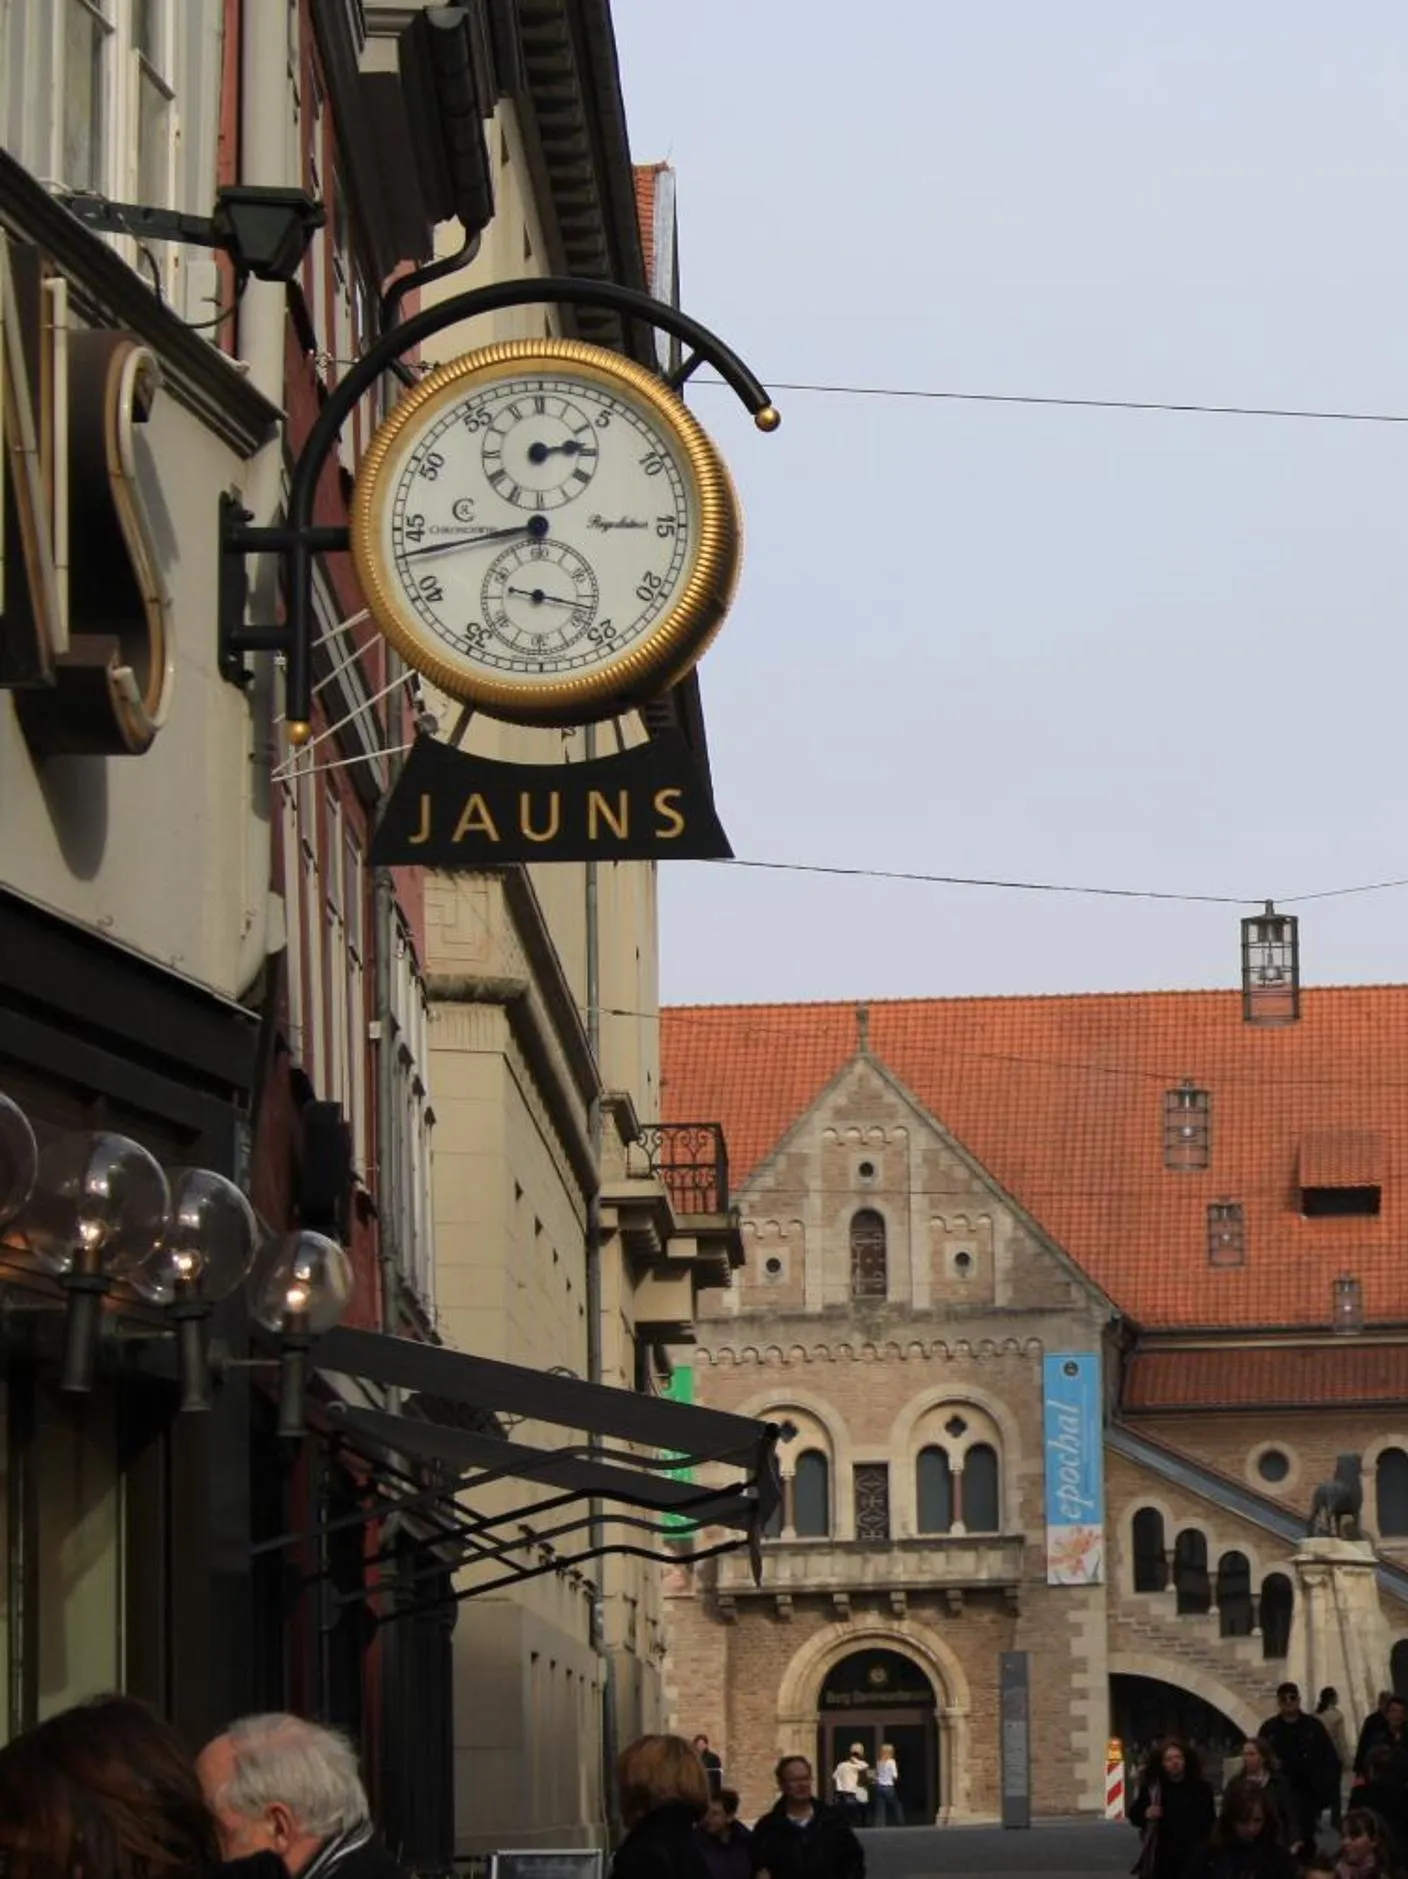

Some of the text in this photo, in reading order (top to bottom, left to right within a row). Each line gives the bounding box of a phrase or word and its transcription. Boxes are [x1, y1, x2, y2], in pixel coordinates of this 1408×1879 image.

[464, 407, 492, 434] 55
[595, 409, 612, 429] 5
[419, 451, 445, 482] 50
[638, 450, 665, 477] 10
[404, 512, 426, 543] 45
[655, 515, 676, 538] 15
[418, 574, 444, 604] 40
[635, 570, 662, 602] 20
[464, 621, 493, 650] 35
[586, 618, 617, 648] 25
[408, 788, 687, 845] JAUNS
[1047, 1398, 1095, 1520] epochal
